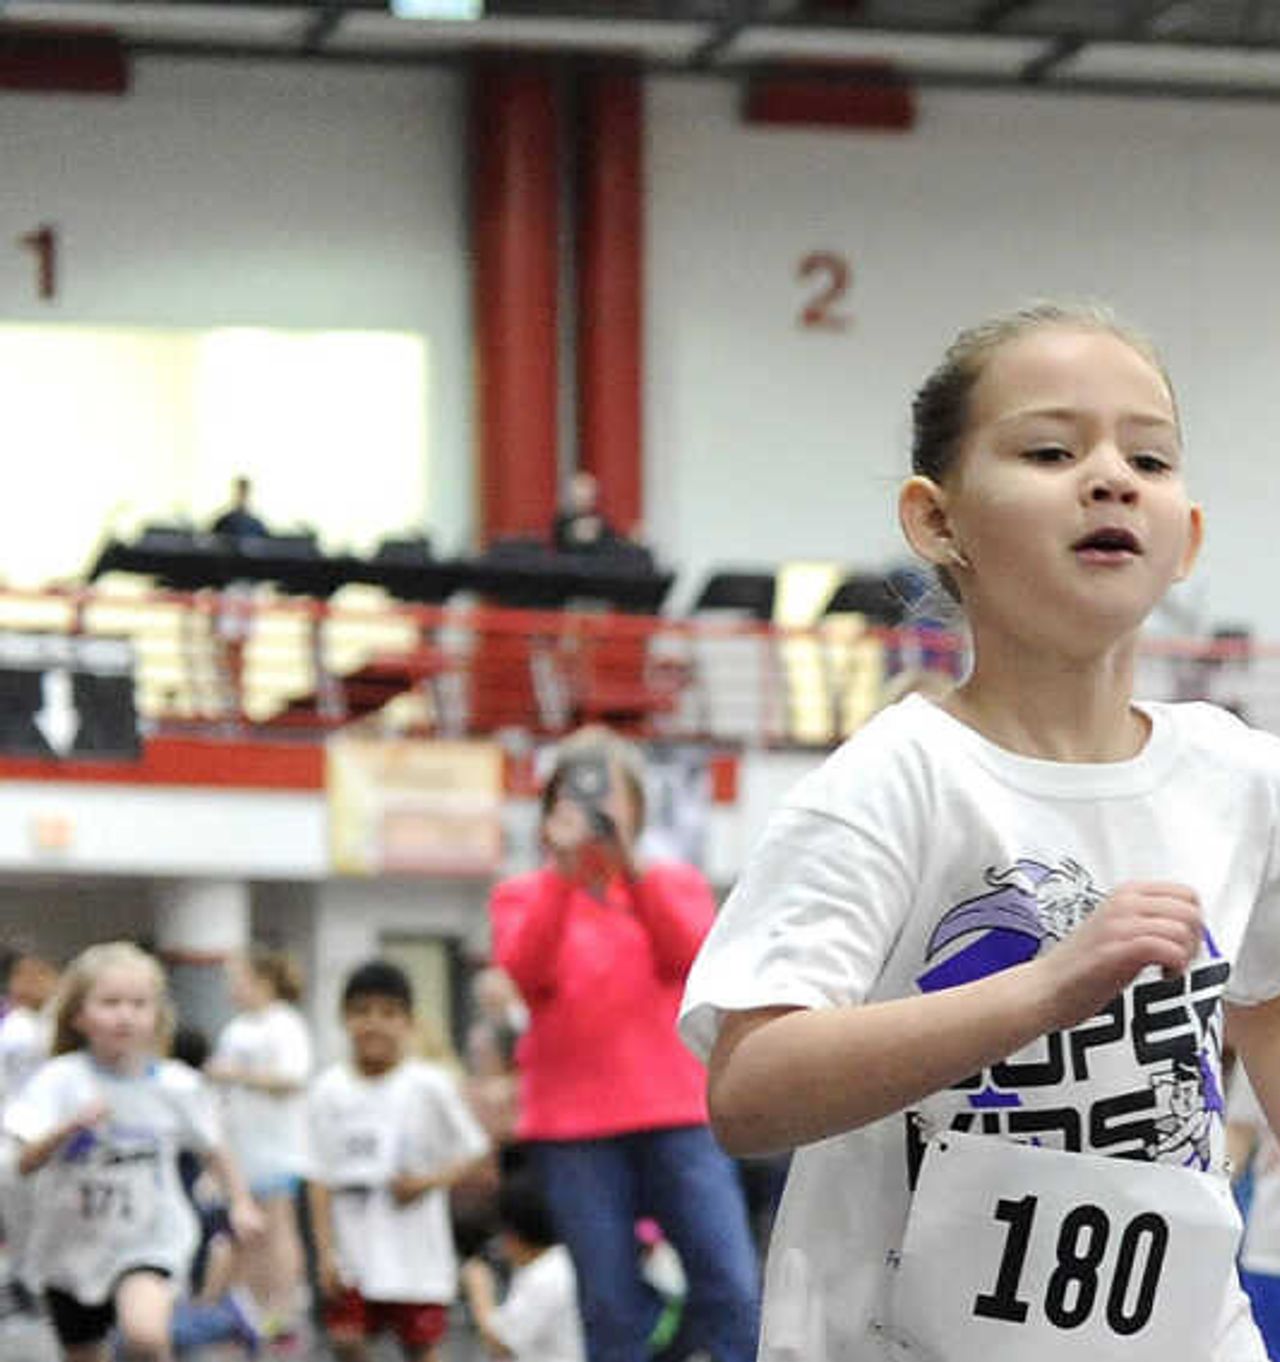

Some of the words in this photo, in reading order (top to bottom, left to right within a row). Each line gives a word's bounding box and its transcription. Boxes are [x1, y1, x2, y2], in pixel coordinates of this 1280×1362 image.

[17, 223, 58, 302] 1
[797, 250, 852, 332] 2
[972, 1194, 1170, 1337] 180
